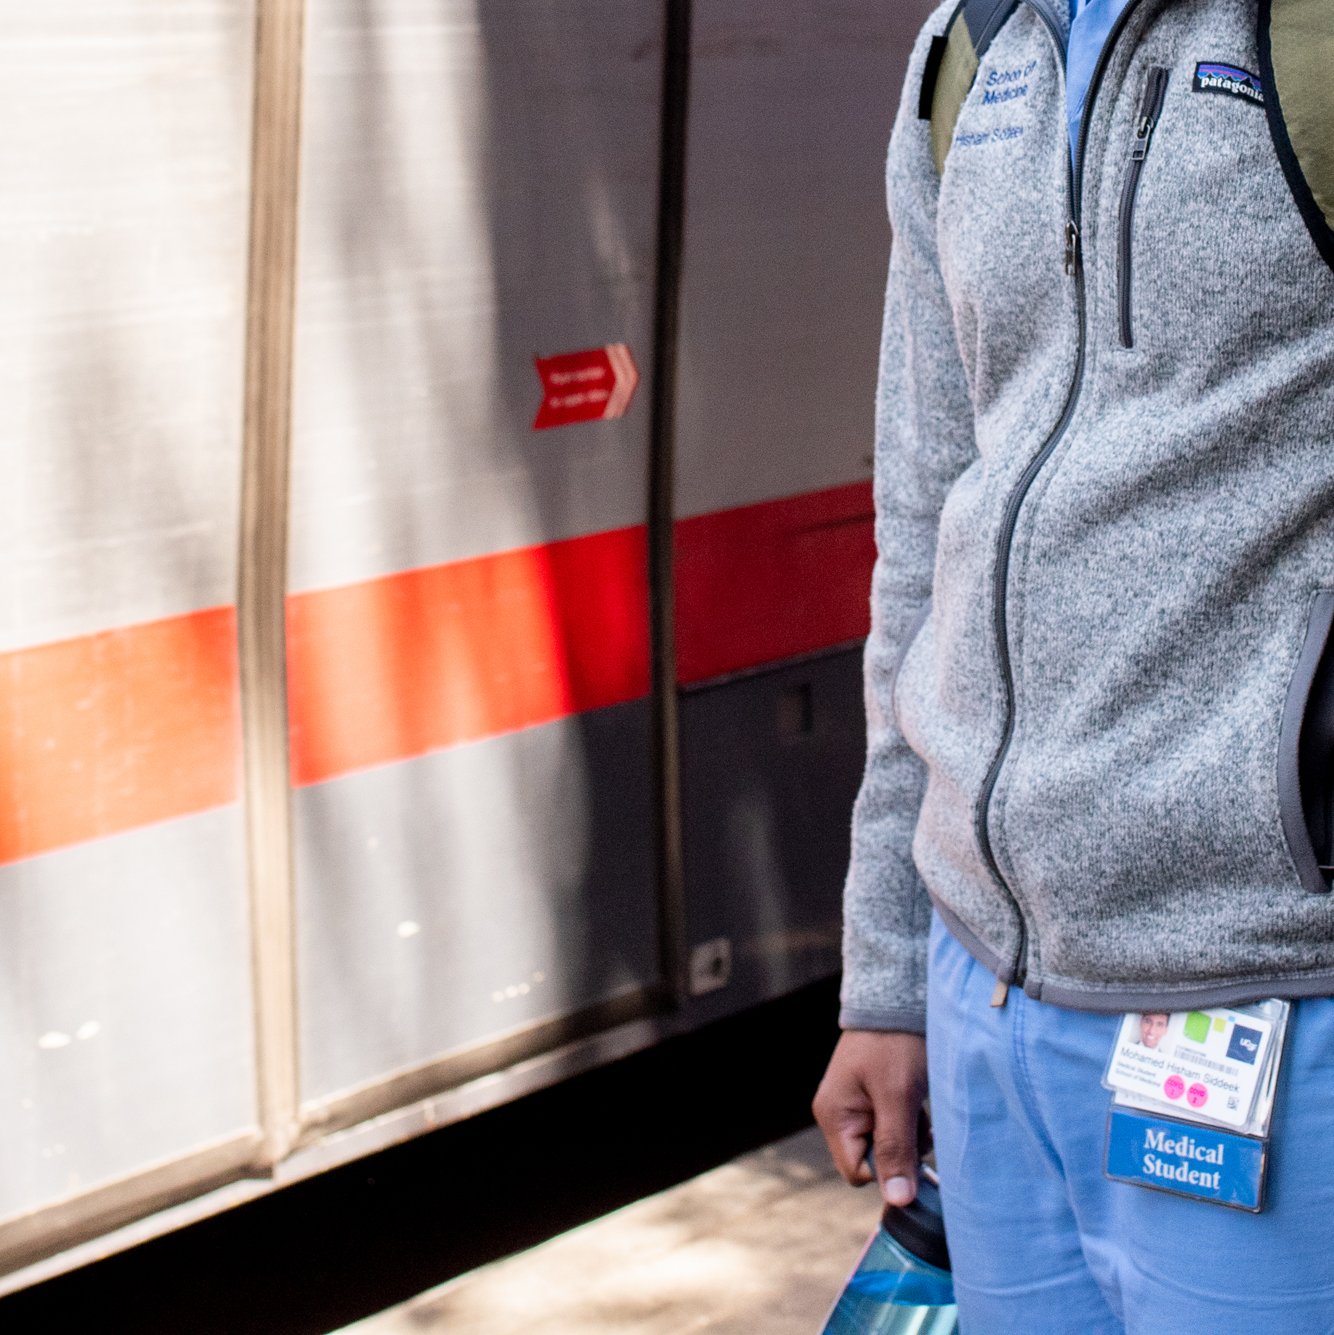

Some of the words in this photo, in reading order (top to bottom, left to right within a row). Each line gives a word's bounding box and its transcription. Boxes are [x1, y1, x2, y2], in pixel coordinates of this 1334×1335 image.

[1200, 76, 1265, 103] patagonia
[1120, 1047, 1165, 1069] Mohamed
[1166, 1061, 1201, 1080] Hisham
[1203, 1073, 1240, 1093] Siddeek
[1143, 1128, 1224, 1165] Medical
[1142, 1153, 1221, 1190] Student
